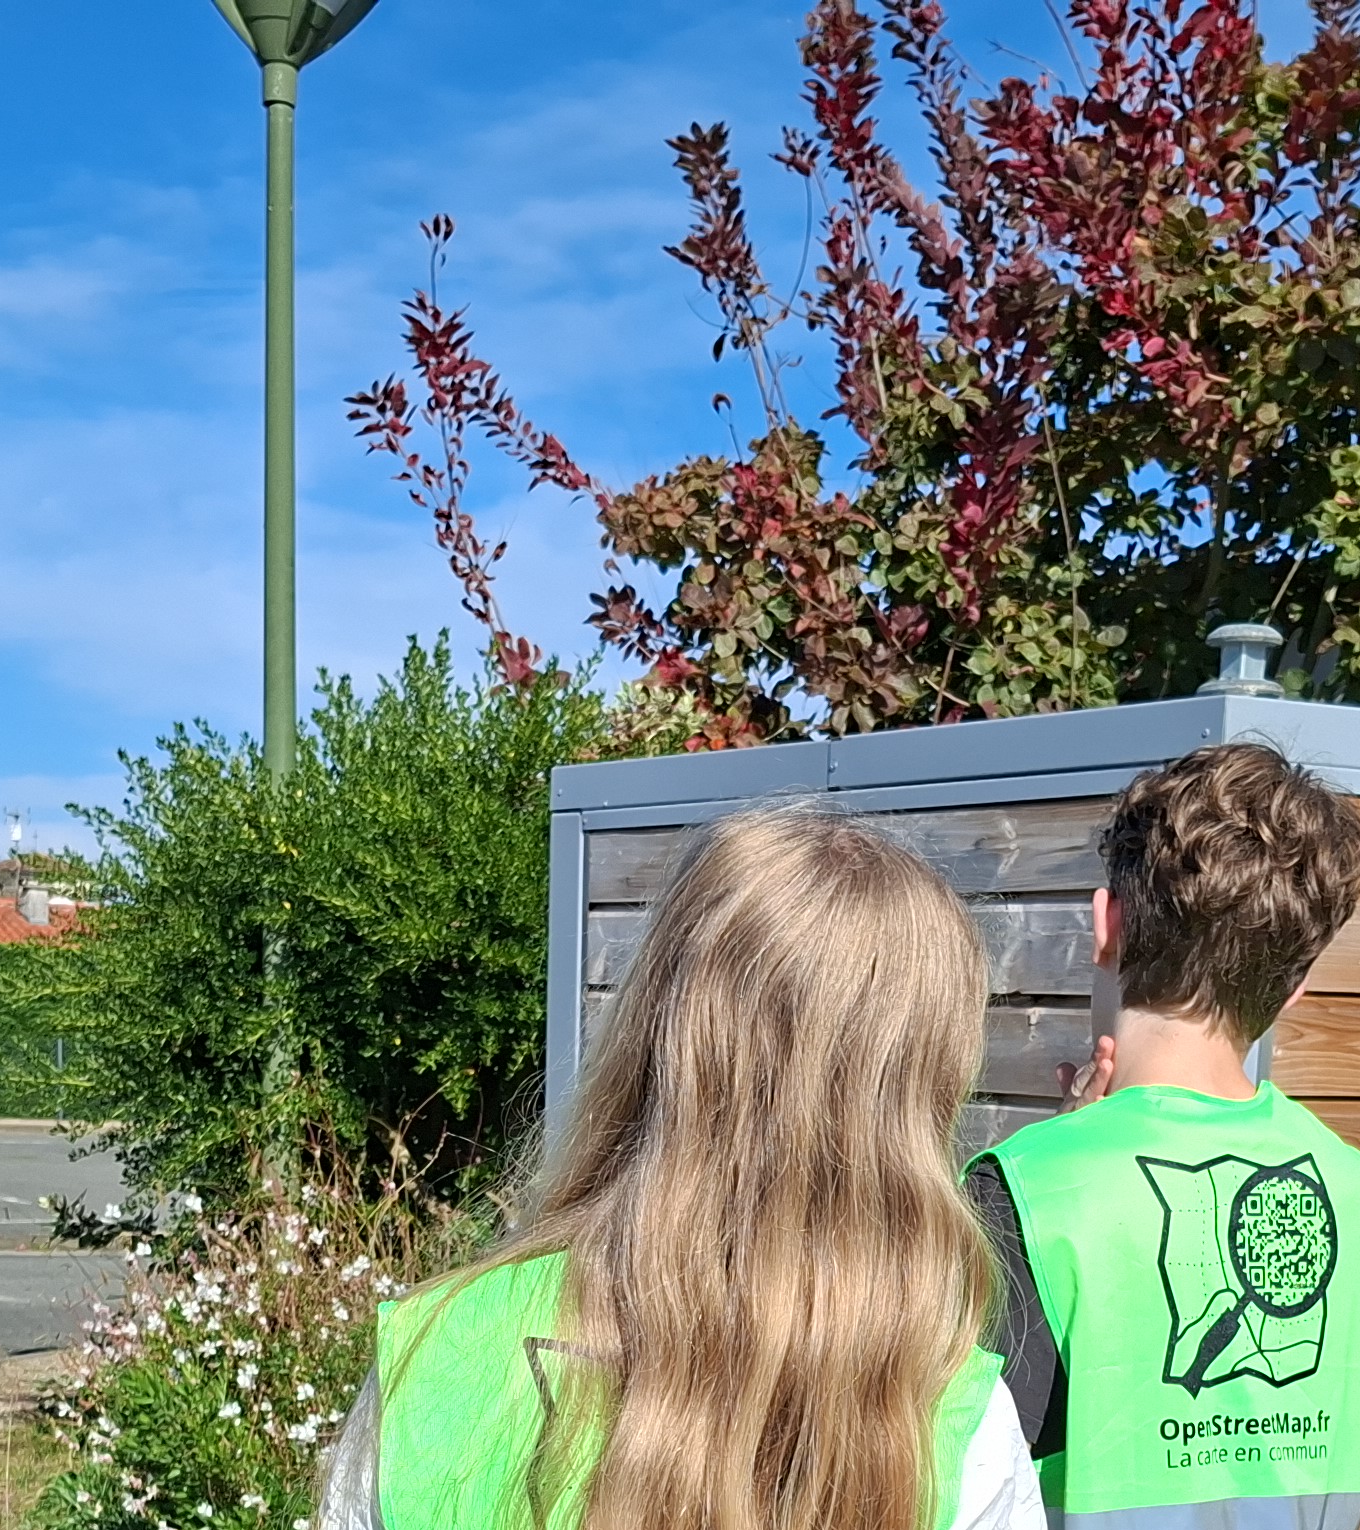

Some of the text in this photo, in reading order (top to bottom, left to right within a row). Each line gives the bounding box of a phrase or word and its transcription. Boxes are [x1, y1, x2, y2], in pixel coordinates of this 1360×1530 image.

[1159, 1410, 1330, 1446] OpenStreetMap.fr
[1167, 1444, 1327, 1469] La carte en commun
